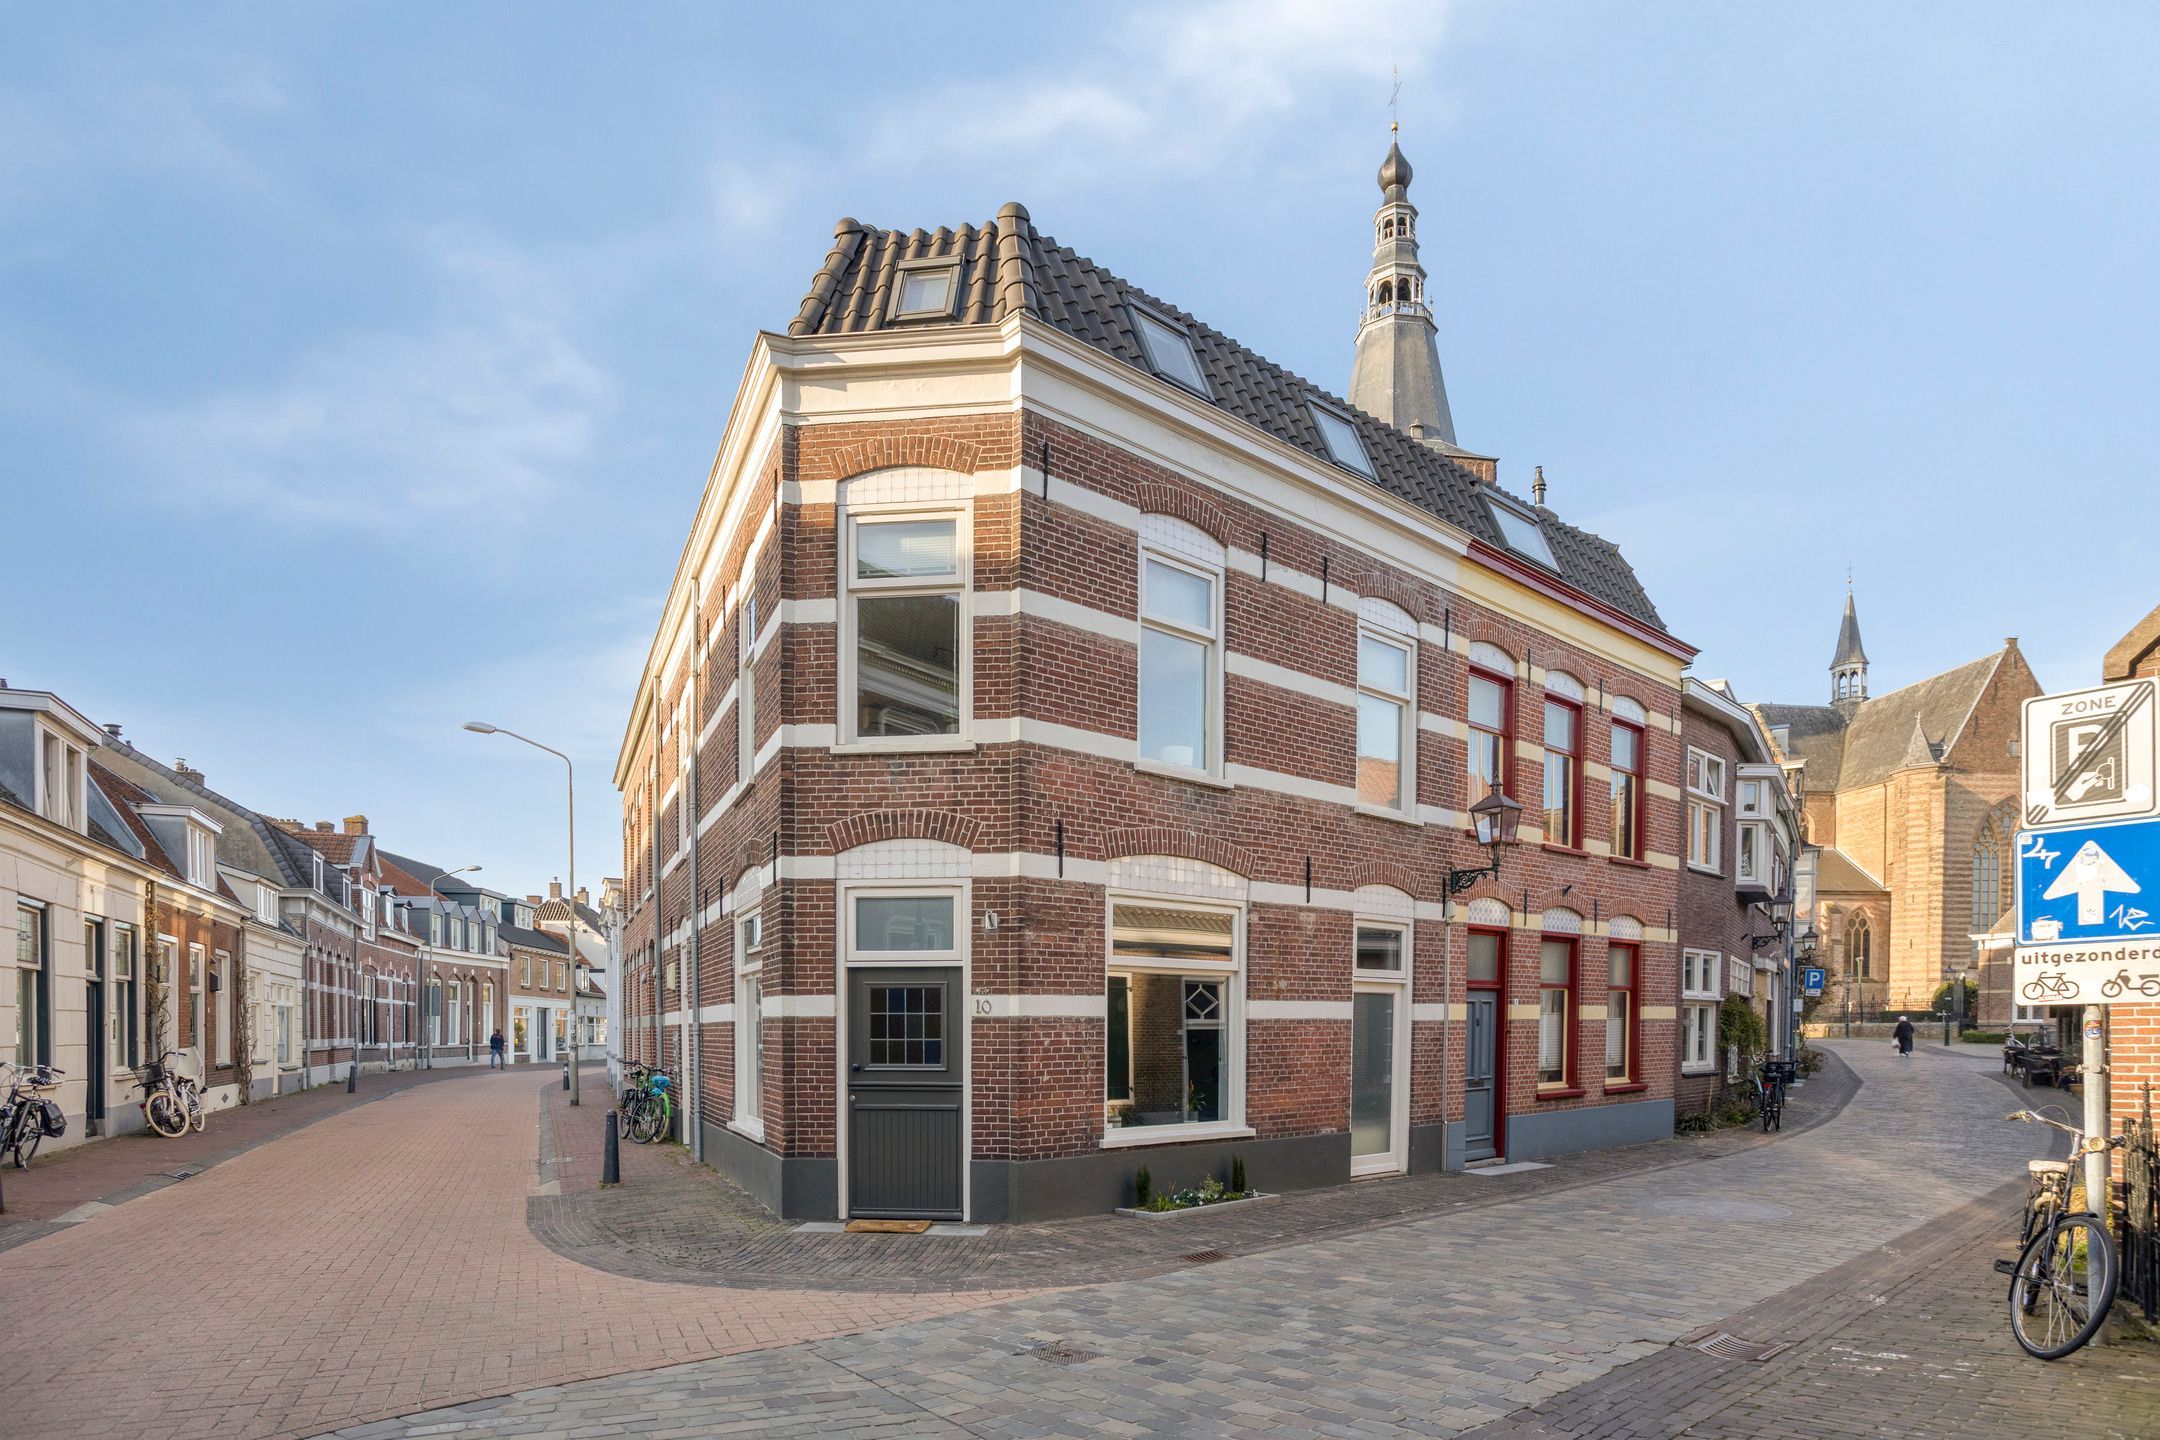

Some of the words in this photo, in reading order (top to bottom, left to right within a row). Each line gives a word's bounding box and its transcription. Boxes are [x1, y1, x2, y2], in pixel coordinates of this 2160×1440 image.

[2061, 696, 2116, 715] ZONE
[1809, 971, 1820, 986] P
[976, 999, 992, 1014] 10
